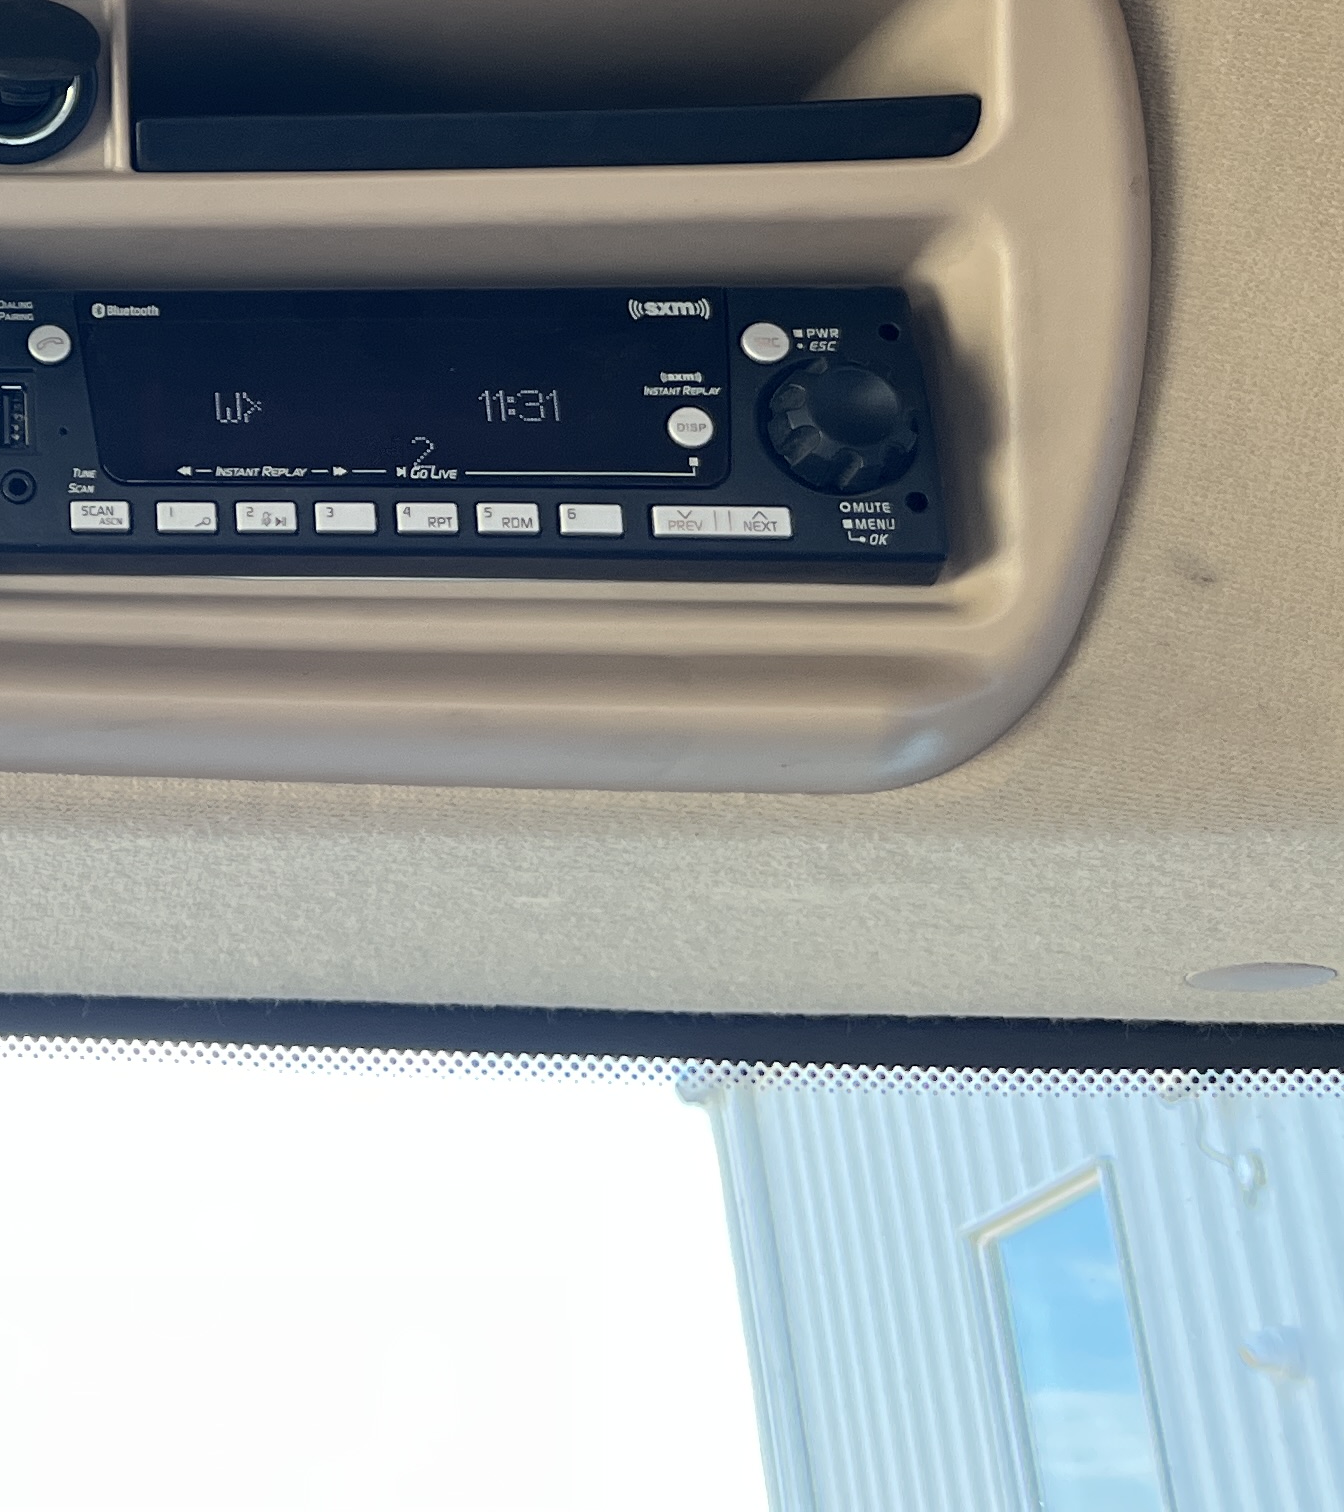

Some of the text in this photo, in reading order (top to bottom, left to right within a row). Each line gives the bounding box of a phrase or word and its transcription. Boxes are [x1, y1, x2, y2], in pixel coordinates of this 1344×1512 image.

[107, 304, 160, 317] Bluetooth
[806, 328, 839, 339] PWR
[809, 341, 837, 351] ESC
[478, 389, 560, 422] 11:31
[676, 422, 707, 433] DISP
[81, 505, 114, 516] SCAN
[246, 506, 254, 517] 2
[325, 506, 334, 518] 3
[403, 506, 411, 518] 4
[483, 506, 492, 518] 5
[852, 502, 891, 513] MUTE
[567, 509, 576, 519] 6
[428, 516, 453, 528] RPT
[502, 517, 534, 529] RDM
[668, 520, 703, 531] PREV
[743, 521, 778, 532] NEXT
[855, 518, 895, 530] MENU
[869, 533, 889, 545] OK
